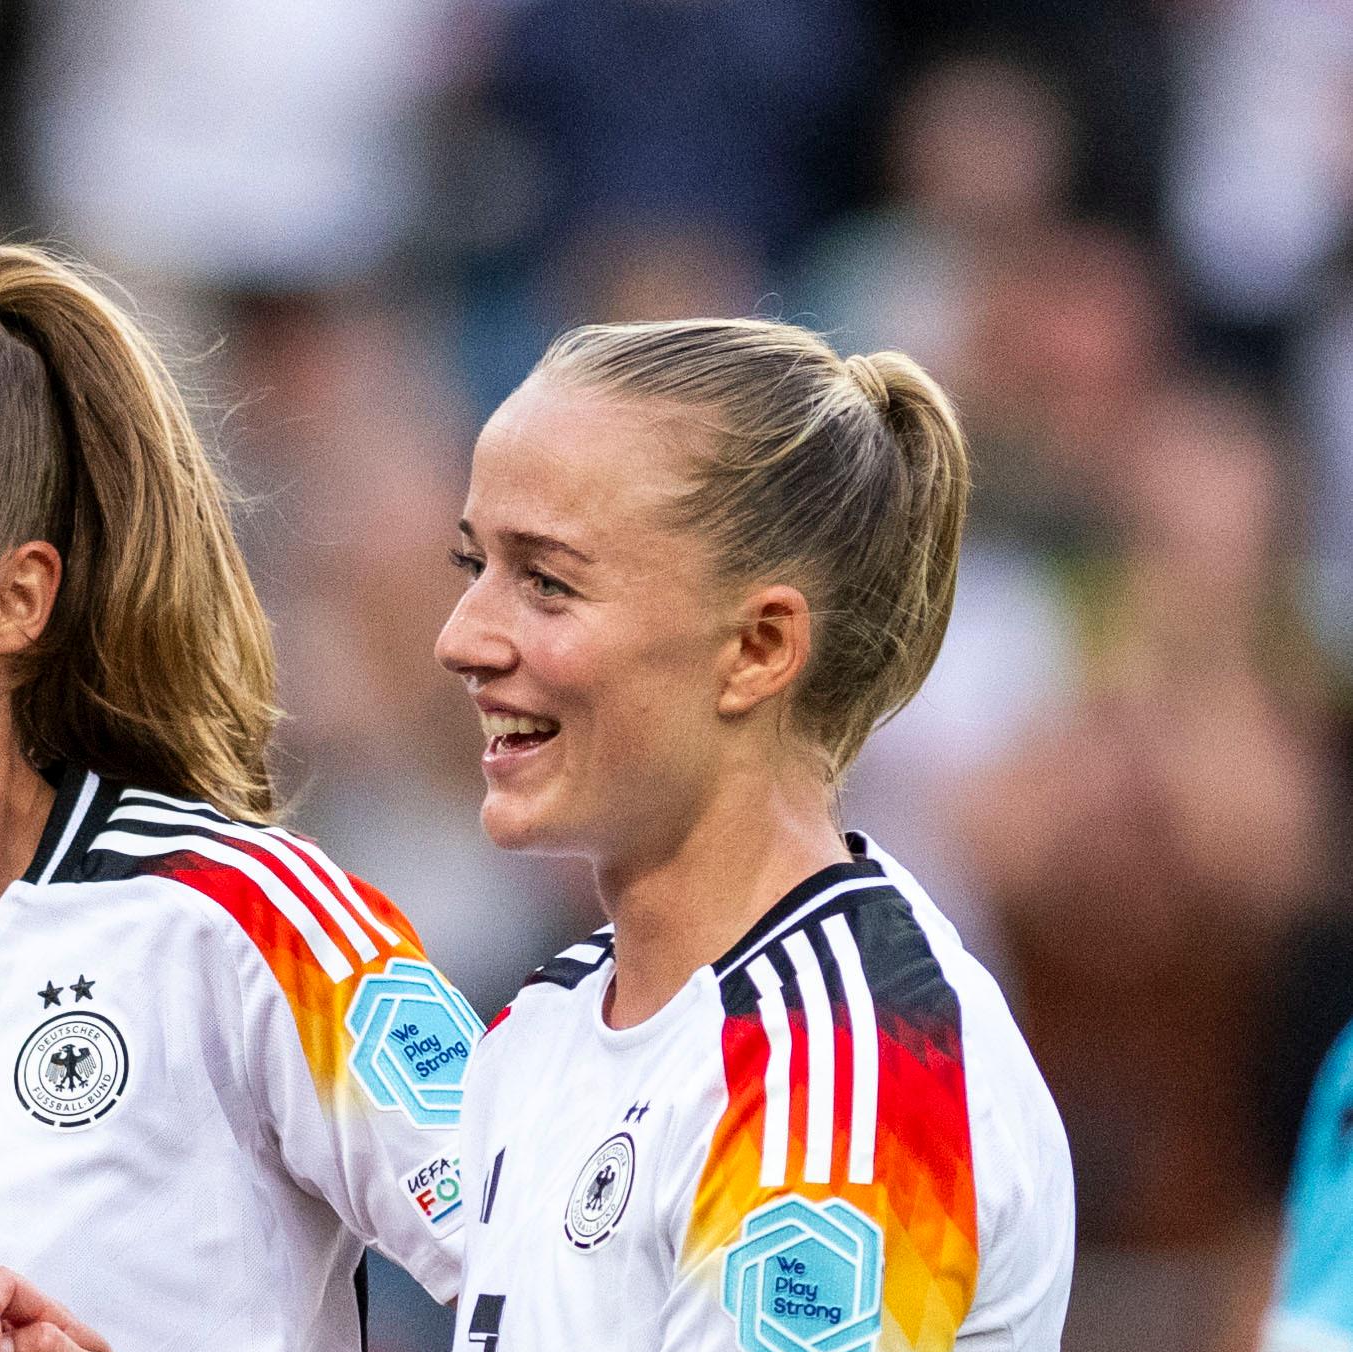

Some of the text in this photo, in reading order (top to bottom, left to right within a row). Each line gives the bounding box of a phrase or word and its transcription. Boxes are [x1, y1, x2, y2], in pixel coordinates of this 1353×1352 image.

[38, 1025, 101, 1052] DEUTSCHER
[391, 1023, 420, 1042] We
[404, 1034, 442, 1061] Play
[416, 1041, 468, 1077] Strong
[33, 1074, 112, 1111] FUSSBALL-BUND
[407, 1158, 451, 1194] UEFA
[776, 1256, 806, 1275] We
[775, 1277, 818, 1301] Play
[773, 1297, 843, 1325] Strong
